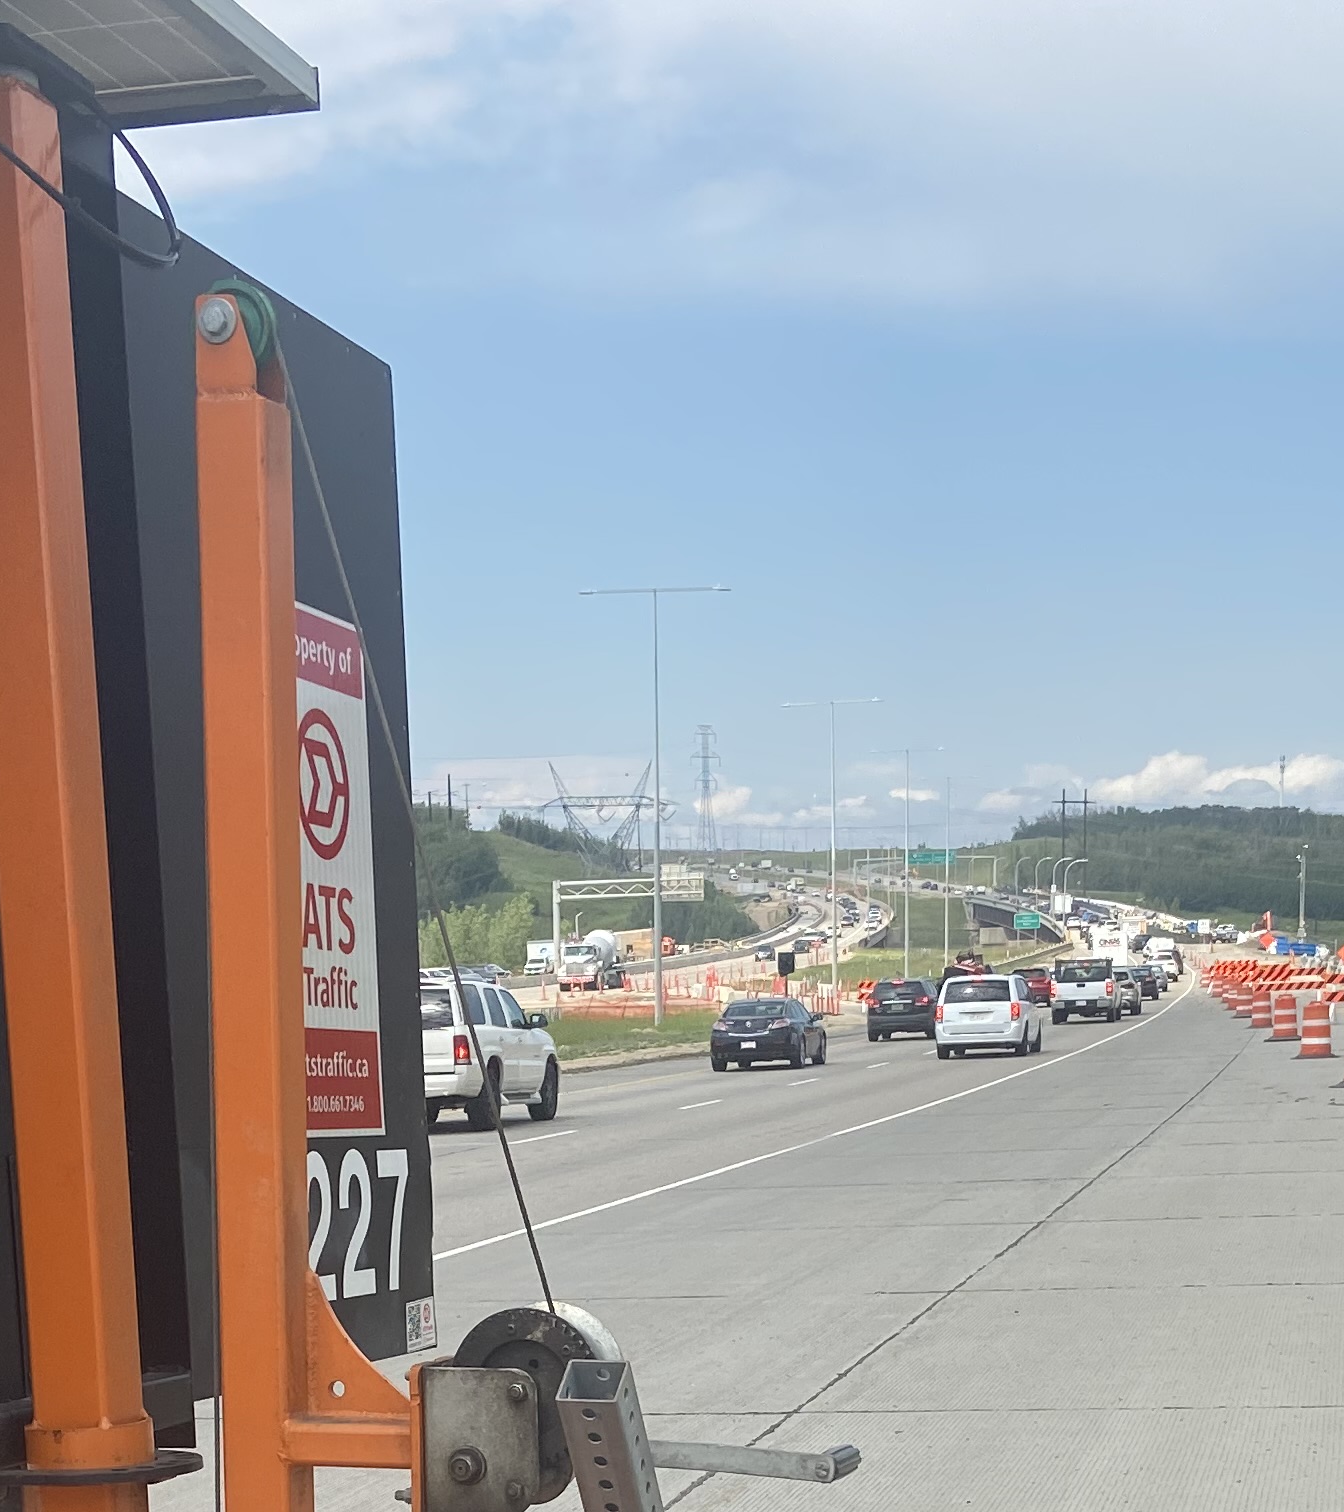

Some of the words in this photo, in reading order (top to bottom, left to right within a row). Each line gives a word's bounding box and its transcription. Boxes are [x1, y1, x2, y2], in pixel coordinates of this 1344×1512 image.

[294, 633, 336, 676] operty
[339, 647, 352, 674] of
[302, 883, 355, 955] ATS
[303, 965, 358, 1010] Traffic
[305, 1050, 369, 1078] tstraffic.ca
[307, 1095, 365, 1113] 1.800.661.7346
